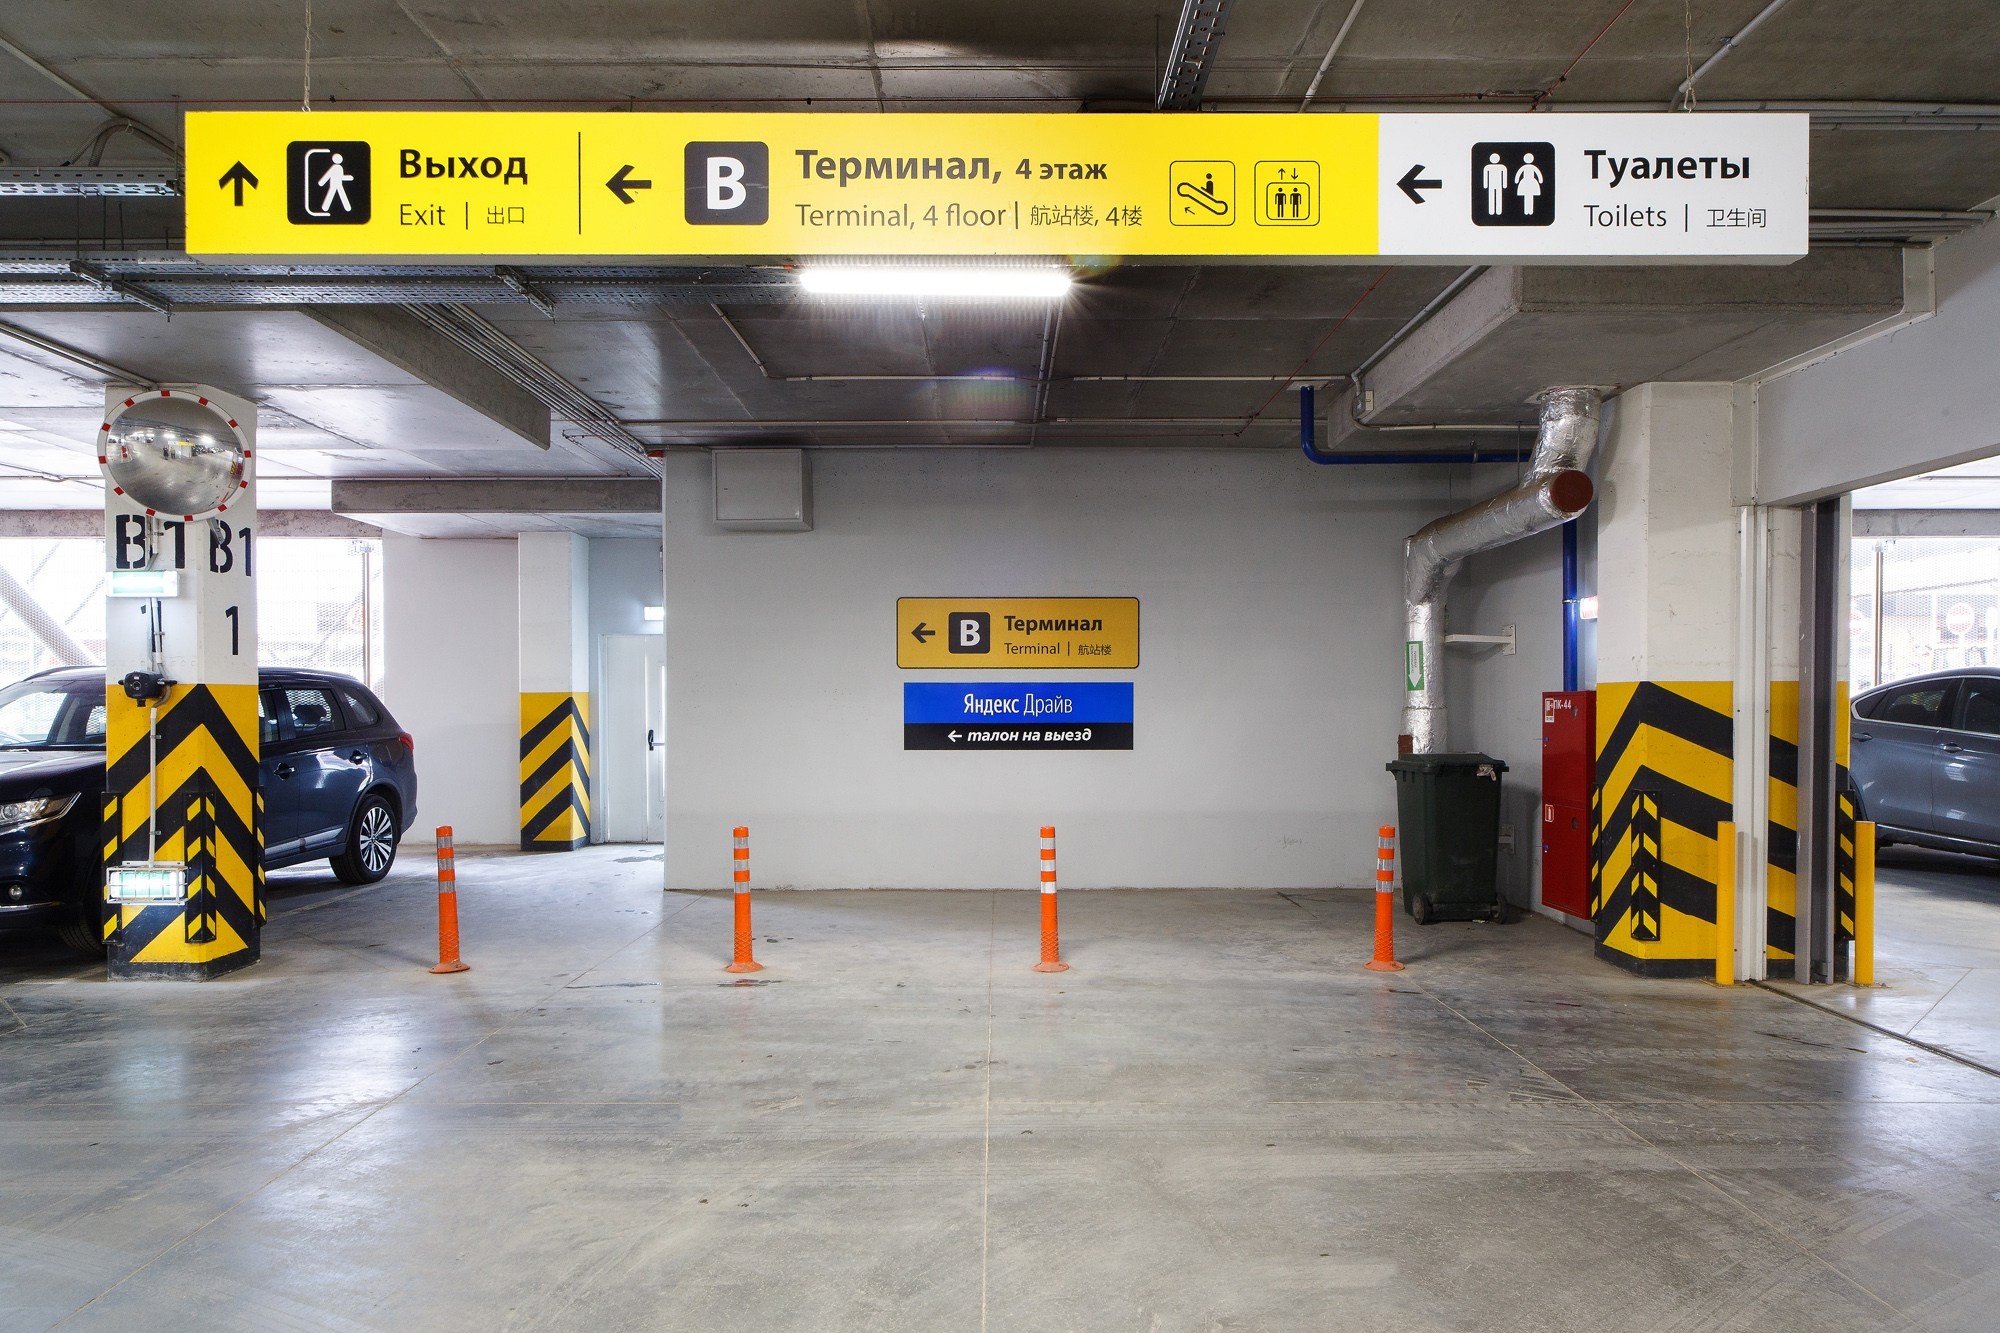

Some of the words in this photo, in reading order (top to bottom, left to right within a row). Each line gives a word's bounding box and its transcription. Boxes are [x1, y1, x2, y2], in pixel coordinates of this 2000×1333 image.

[399, 149, 528, 185] Выход
[795, 149, 1002, 188] Терминал,
[1015, 158, 1033, 180] 4
[1039, 164, 1108, 180] этаж
[1584, 149, 1750, 188] Туалеты
[707, 157, 747, 210] B
[400, 204, 446, 226] Exit
[487, 206, 525, 225] 出口
[795, 204, 915, 229] Terminal,
[922, 205, 938, 227] 4
[945, 203, 1007, 227] floor
[1584, 203, 1667, 227] Toilets
[1706, 208, 1767, 228] 卫生间
[225, 605, 239, 656] 1
[960, 619, 981, 647] B
[1004, 616, 1103, 635] Терминал
[1004, 642, 1060, 655] Terminal
[1077, 644, 1112, 656] 航站楼
[963, 694, 1020, 715] Яндекс
[1023, 694, 1073, 717] Драйв
[967, 732, 1019, 742] талон
[1022, 732, 1041, 742] на
[1044, 728, 1092, 742] выезд
